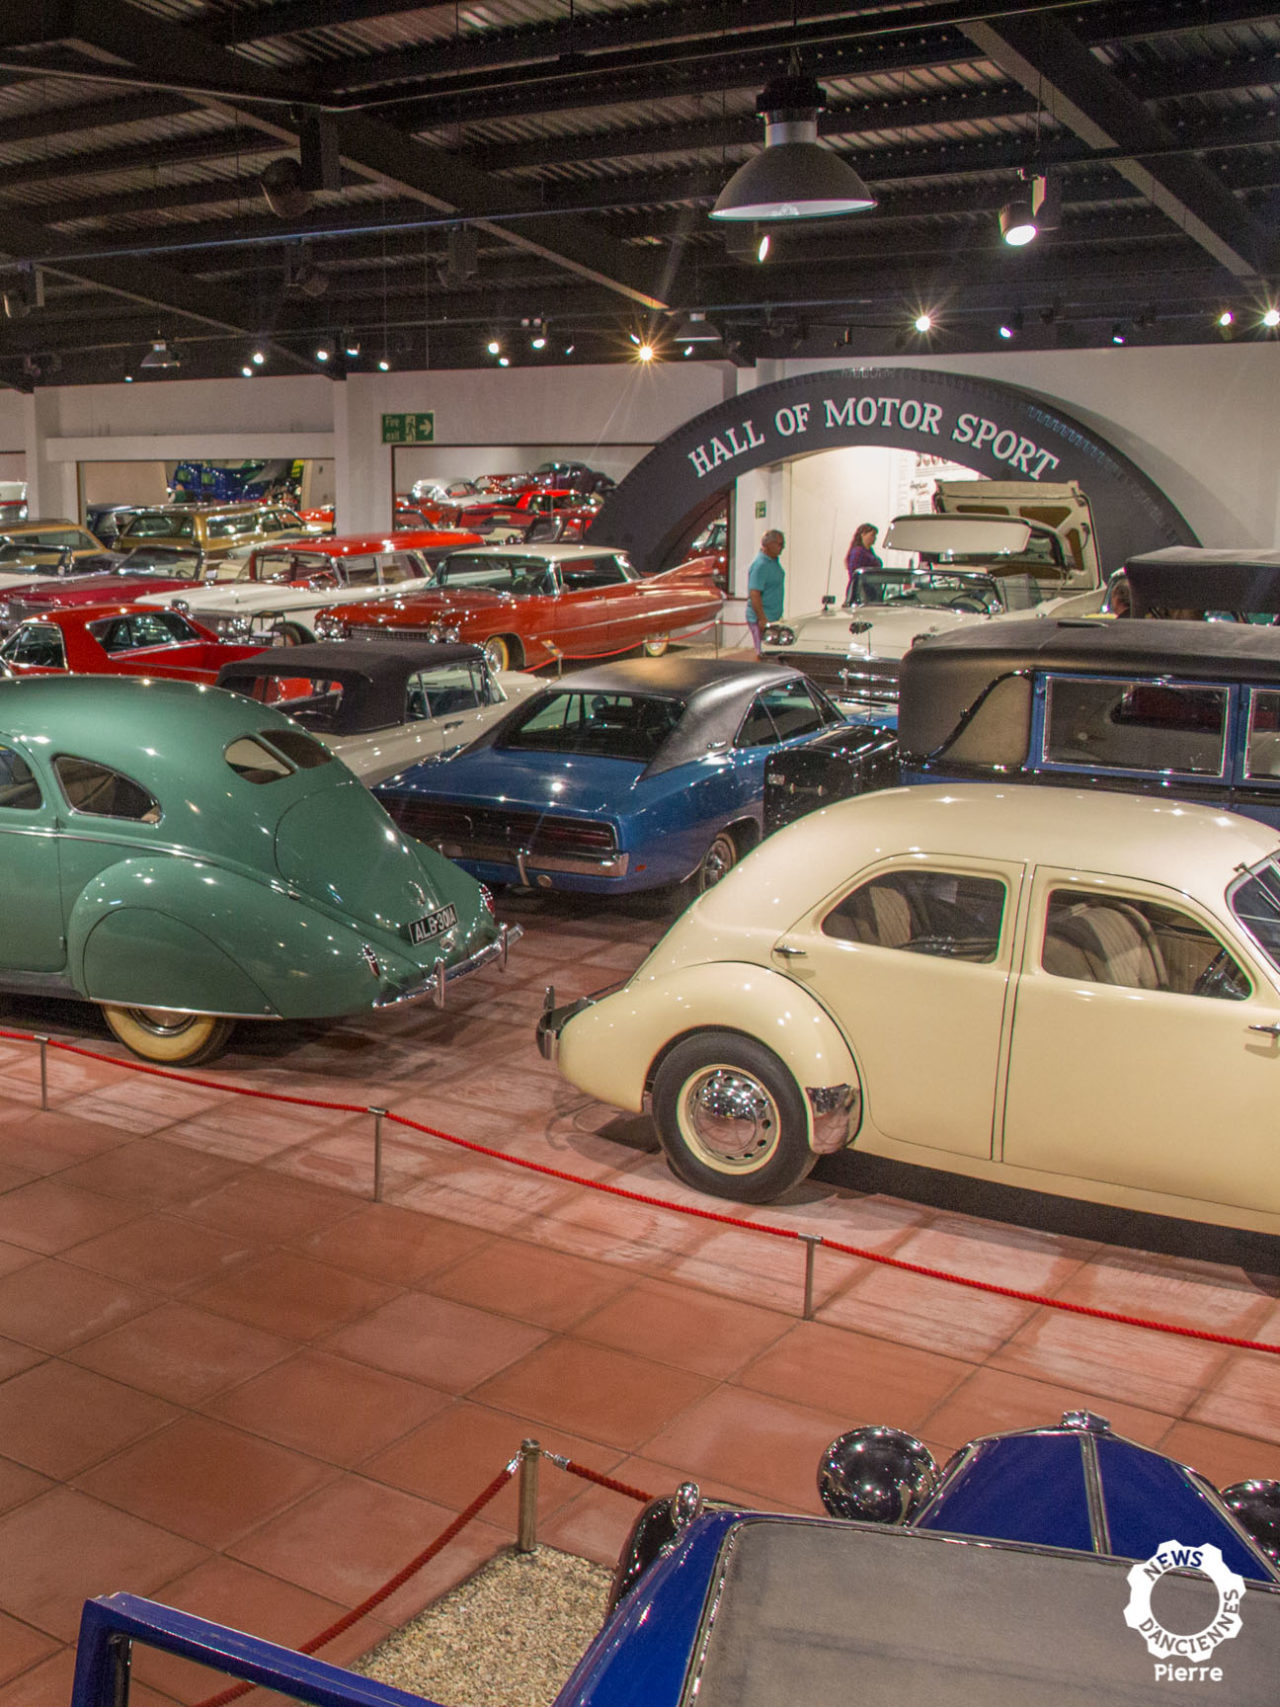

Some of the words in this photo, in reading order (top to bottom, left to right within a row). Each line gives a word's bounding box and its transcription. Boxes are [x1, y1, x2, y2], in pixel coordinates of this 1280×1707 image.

[688, 420, 766, 477] HALL
[775, 403, 811, 436] OF
[823, 397, 943, 435] MOTOR
[952, 413, 1060, 480] SPORT
